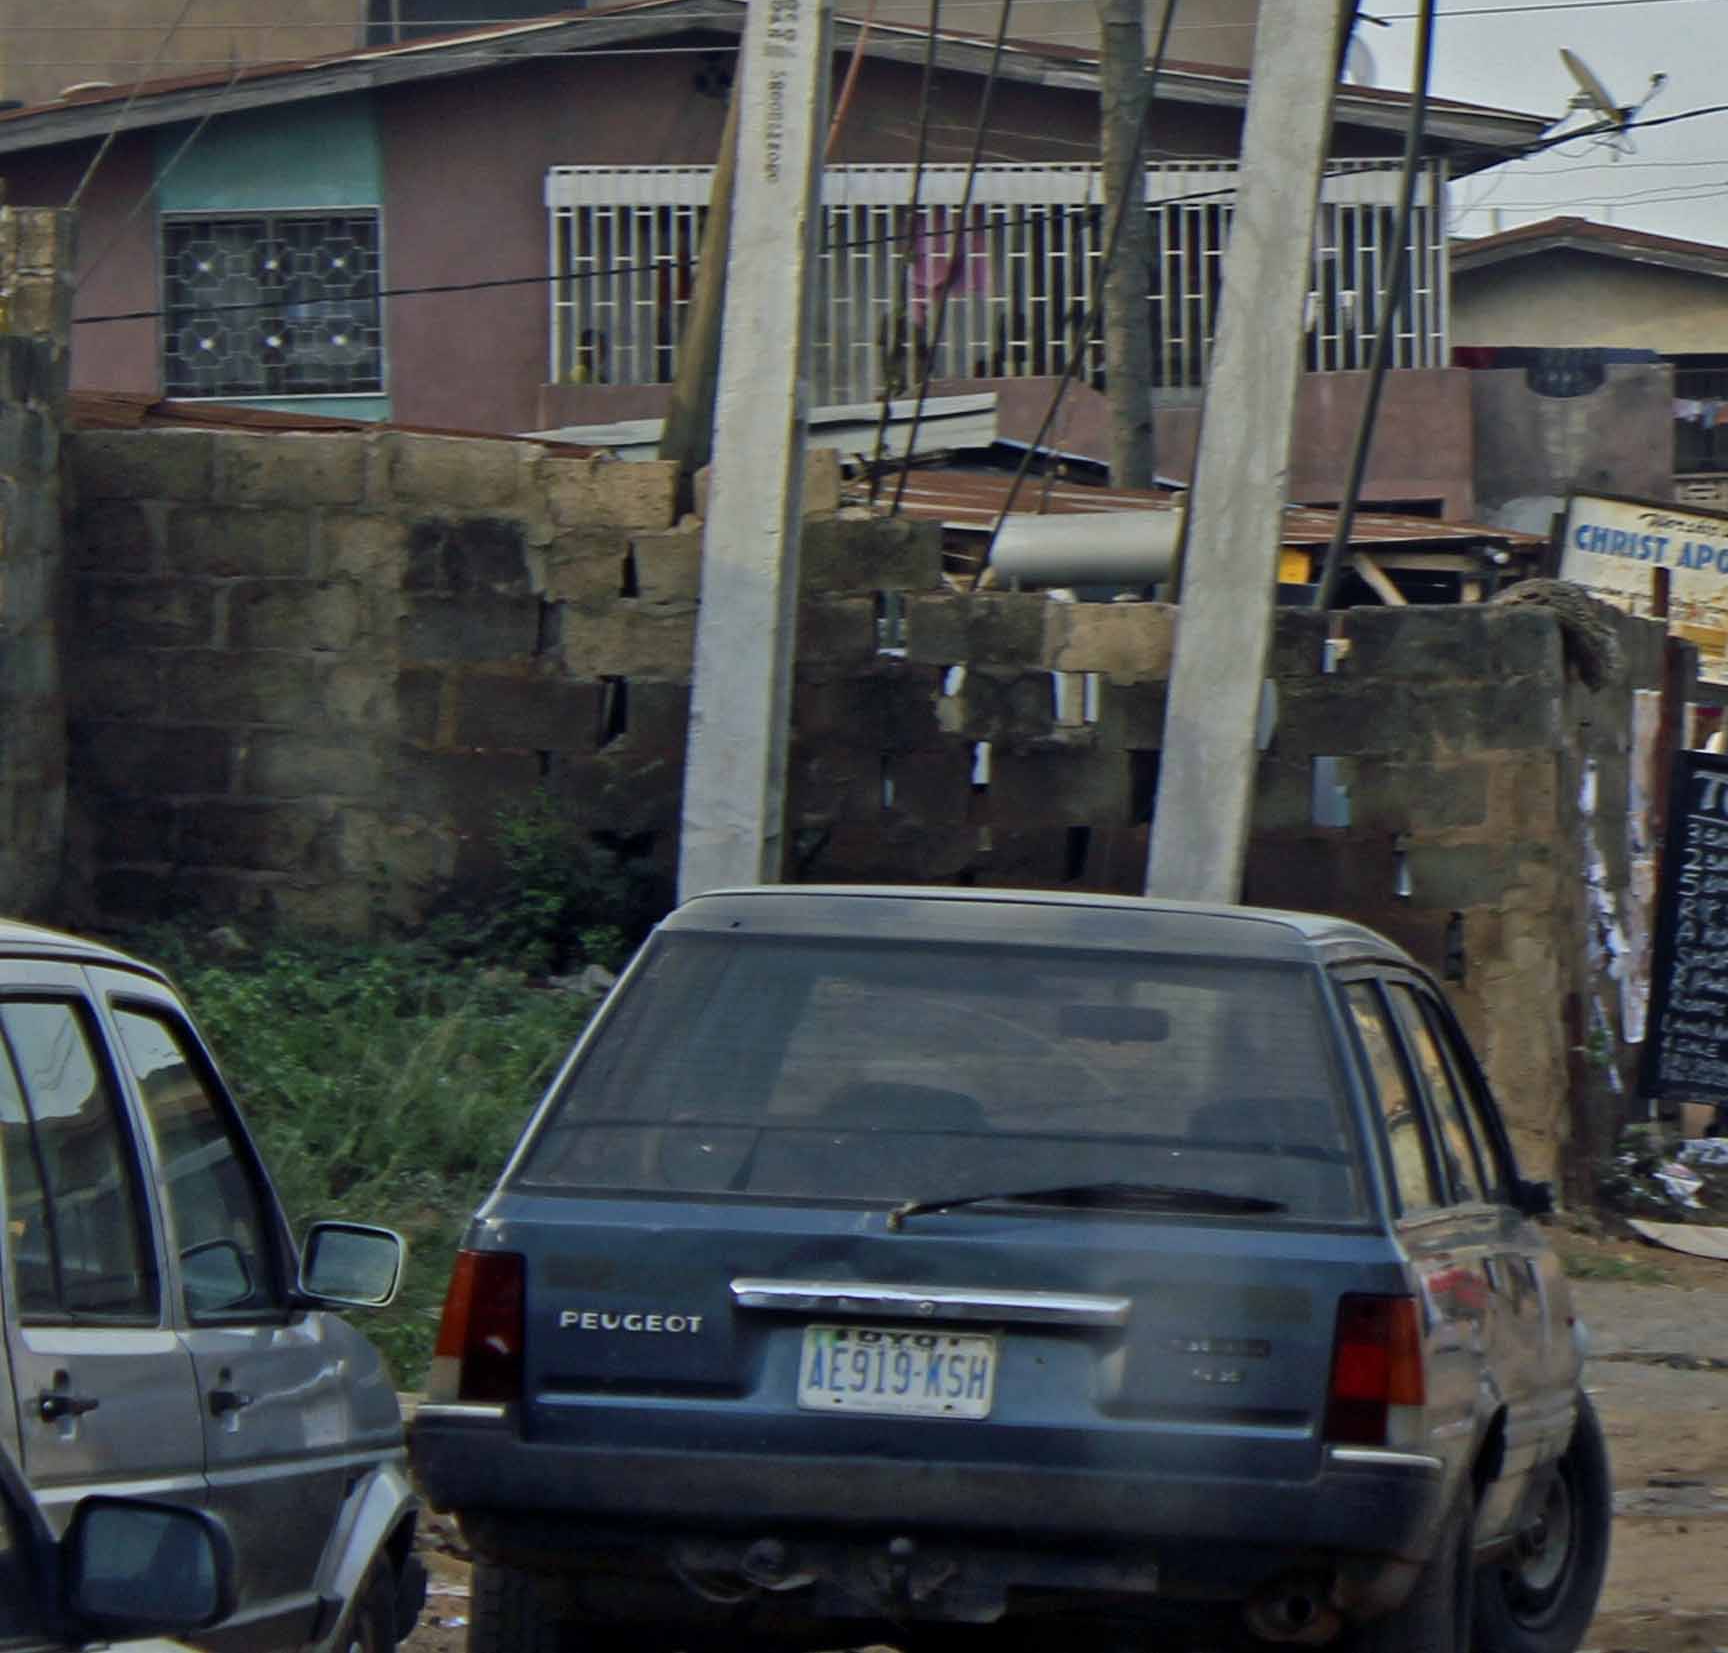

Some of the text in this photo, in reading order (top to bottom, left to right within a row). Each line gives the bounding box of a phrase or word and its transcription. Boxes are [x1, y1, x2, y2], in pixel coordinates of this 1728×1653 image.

[1576, 524, 1670, 563] CHRIST
[1682, 847, 1702, 871] 2
[559, 1310, 704, 1333] PEUGEOT
[806, 1345, 990, 1401] AE919-KSH
